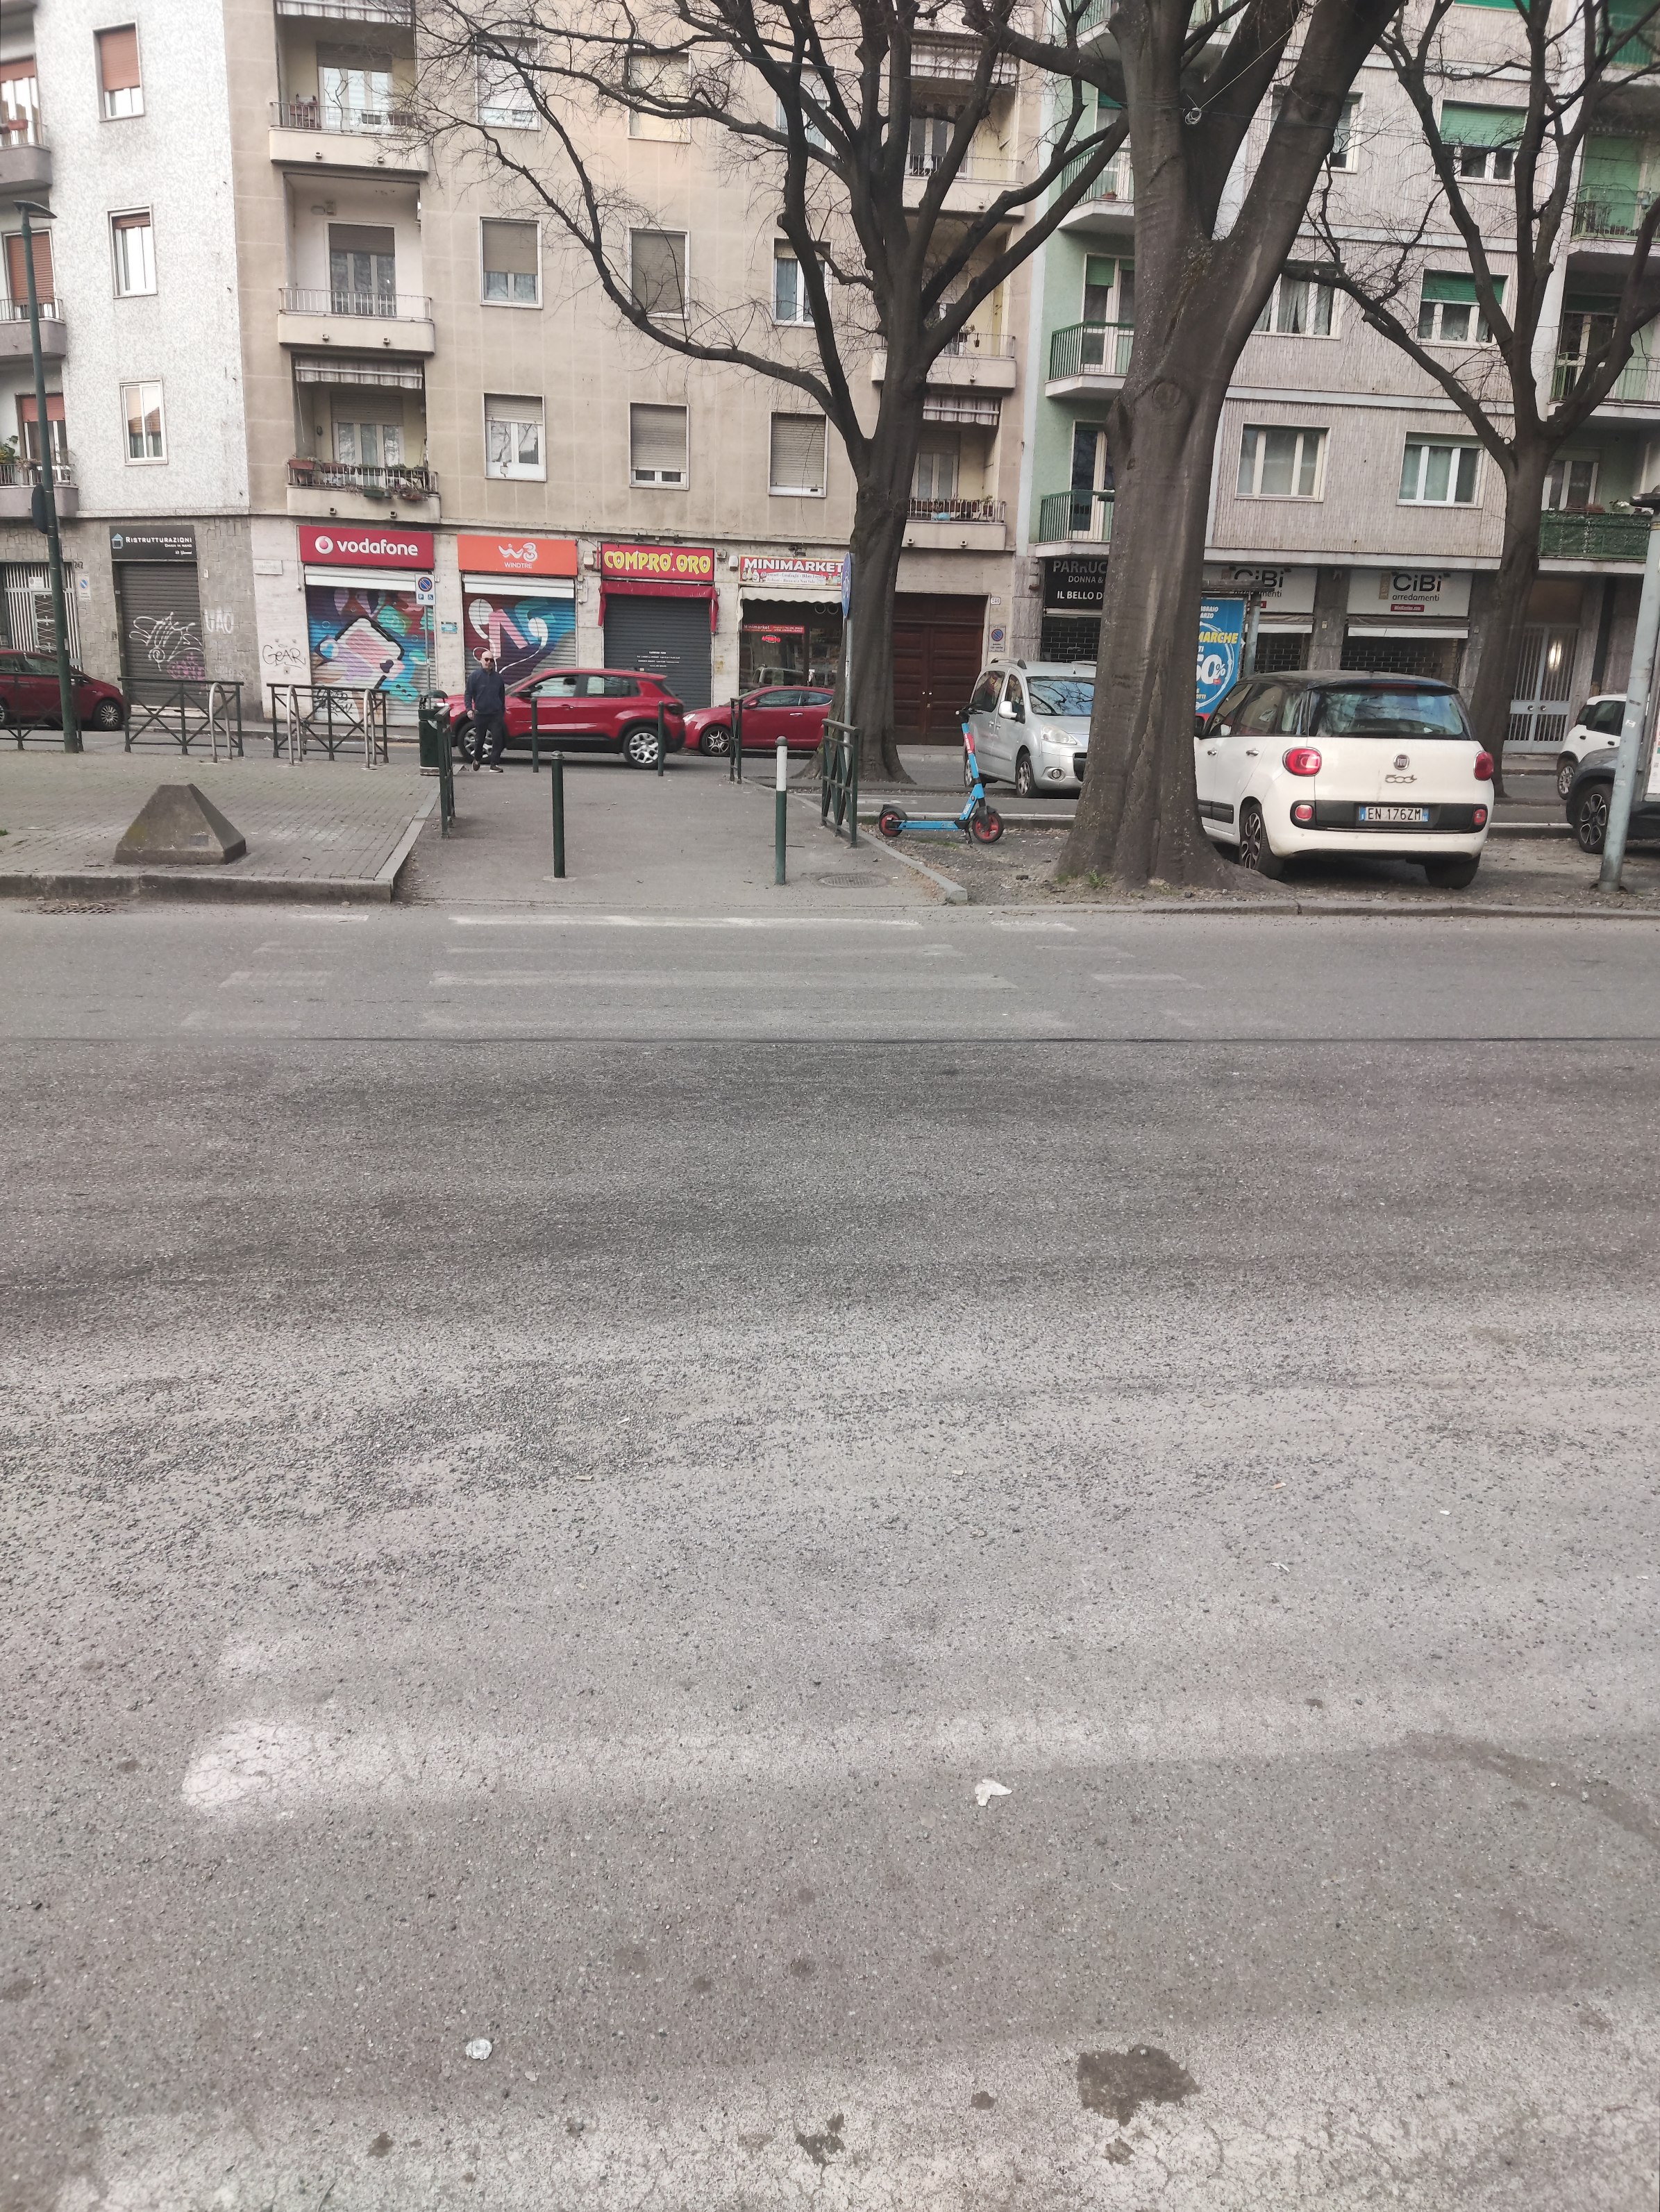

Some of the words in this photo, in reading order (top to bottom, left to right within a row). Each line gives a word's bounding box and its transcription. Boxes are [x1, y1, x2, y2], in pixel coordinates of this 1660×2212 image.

[337, 538, 419, 556] vodafone
[604, 551, 671, 573] COMPRO
[676, 554, 711, 575] ORO
[744, 558, 844, 573] MINIMARKET
[1393, 573, 1442, 592] CiBi
[1057, 590, 1065, 599] IL
[1066, 591, 1094, 600] BELLO
[1392, 594, 1440, 602] arredamenti
[1368, 807, 1382, 820] EN
[1387, 808, 1422, 821] 176ZM
